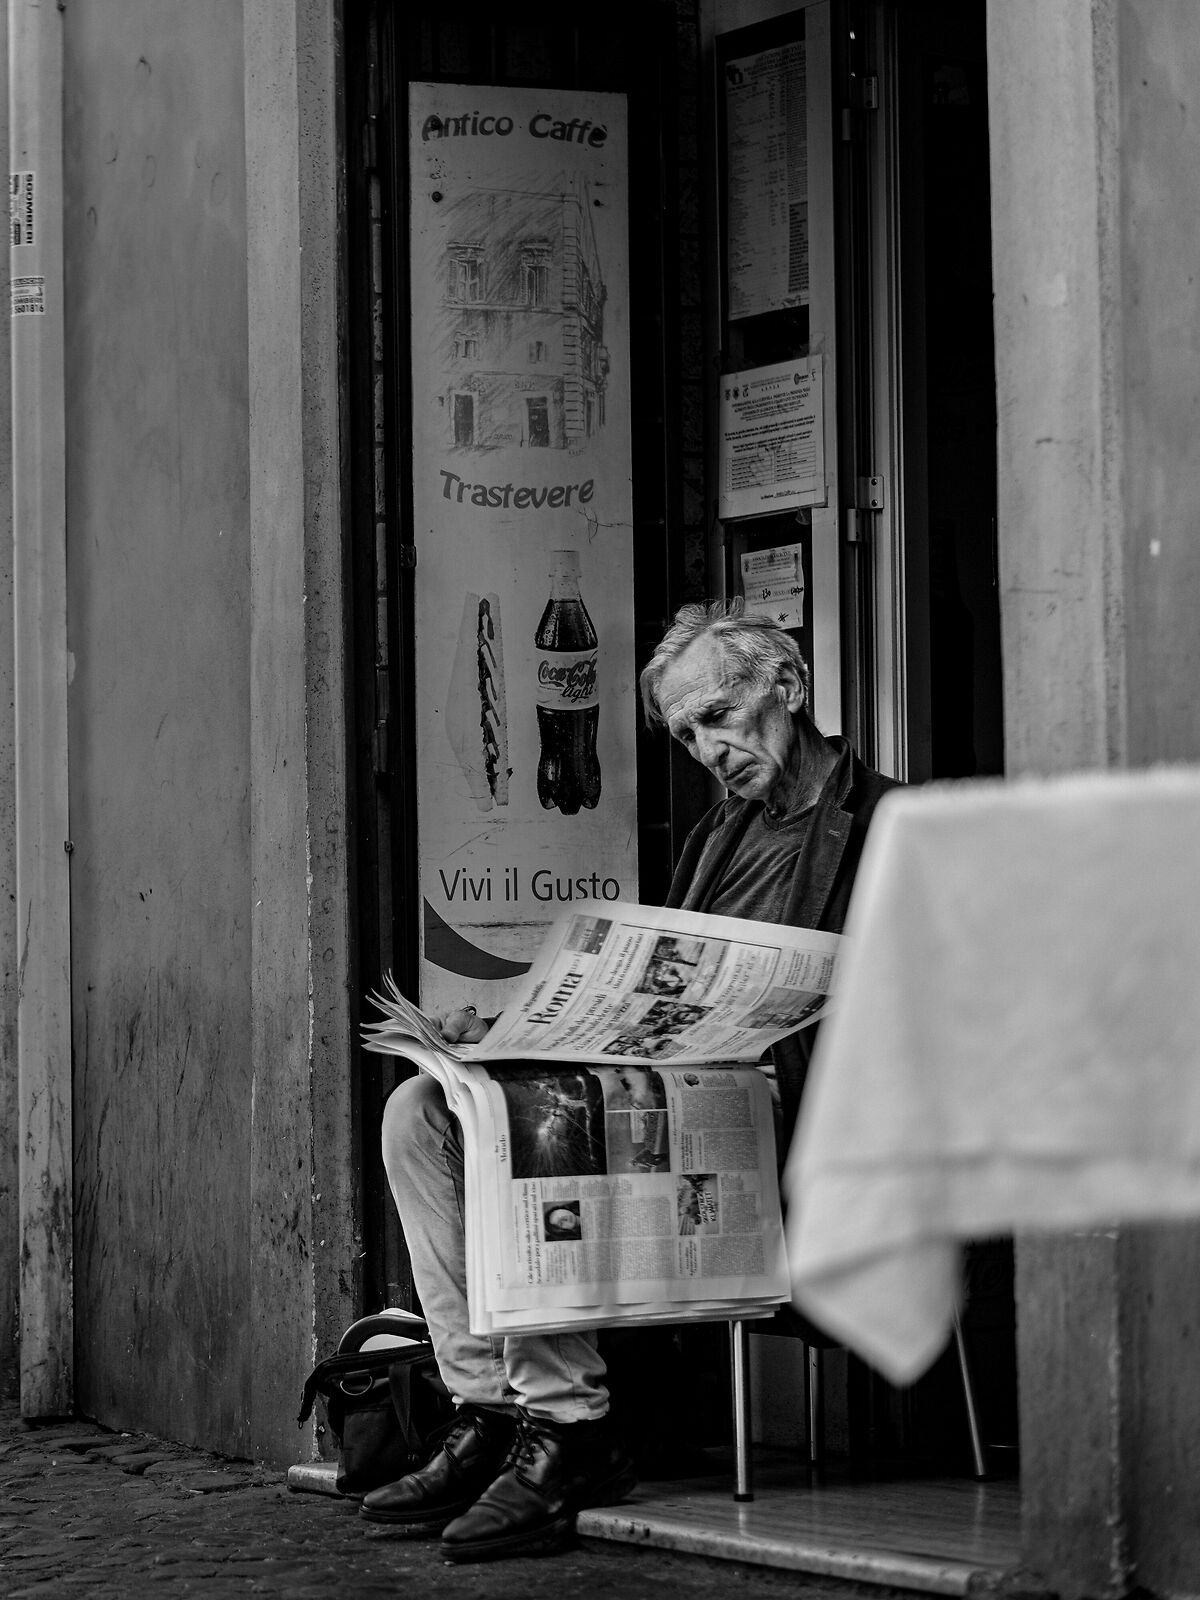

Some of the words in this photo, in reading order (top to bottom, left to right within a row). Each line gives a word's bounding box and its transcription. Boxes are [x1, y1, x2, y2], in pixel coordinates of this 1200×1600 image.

[421, 111, 514, 142] Antico
[439, 469, 594, 509] Trastevere
[561, 685, 594, 703] light
[438, 867, 492, 902] Vivi
[504, 866, 519, 902] il
[531, 869, 621, 902] Gusto
[527, 973, 584, 1024] Roma
